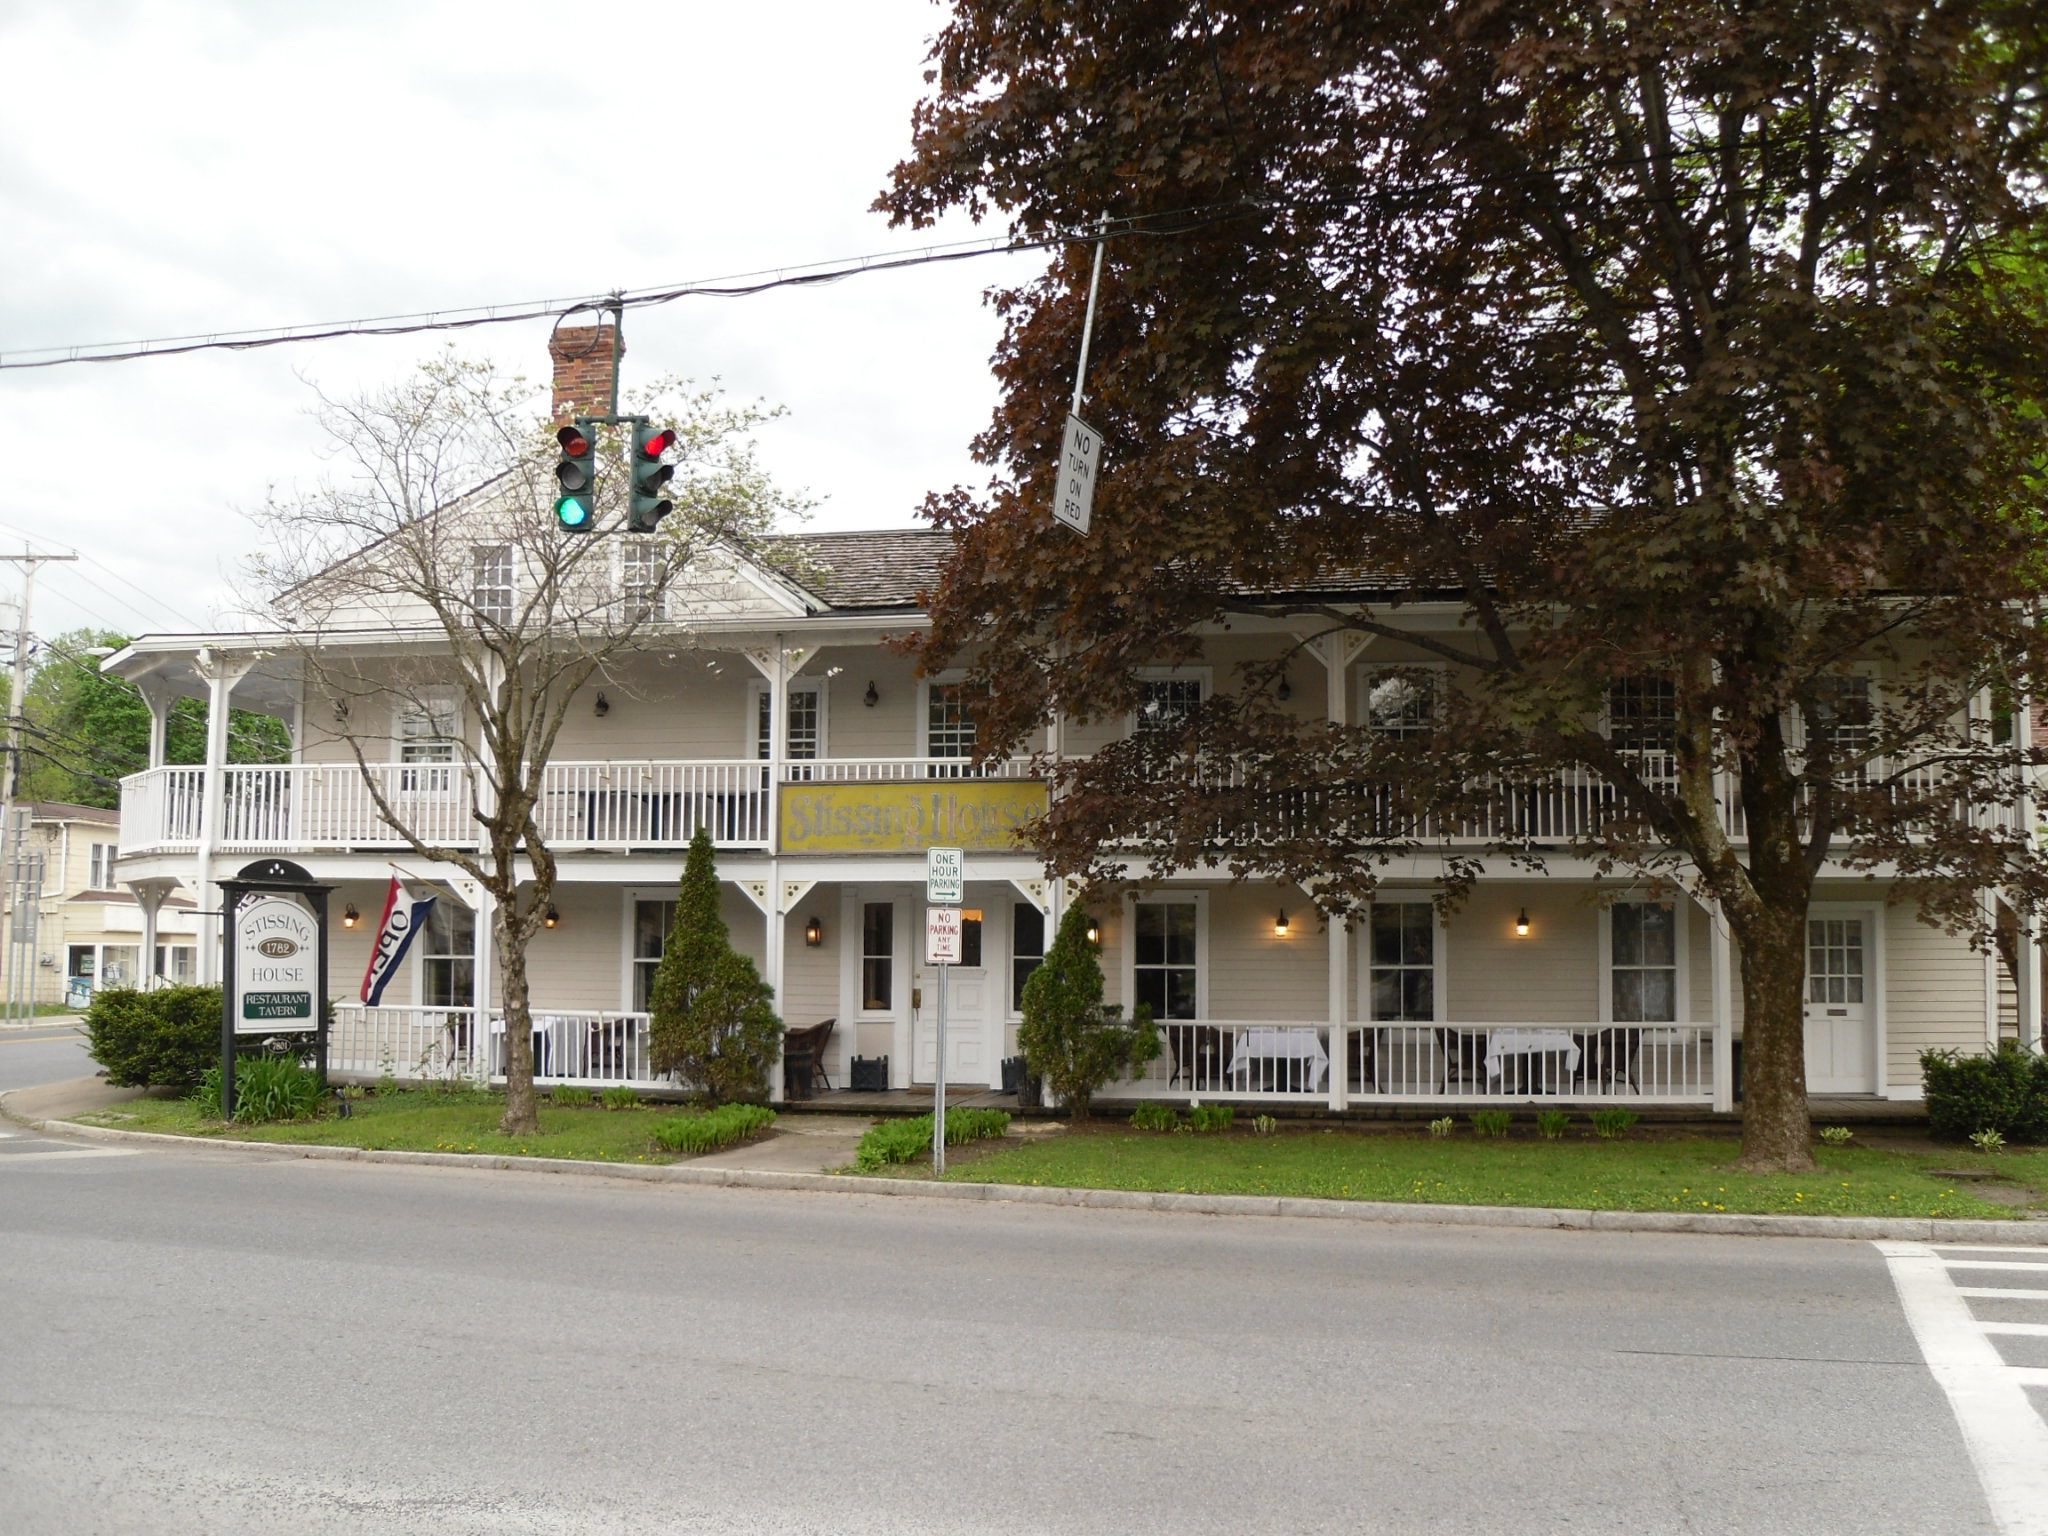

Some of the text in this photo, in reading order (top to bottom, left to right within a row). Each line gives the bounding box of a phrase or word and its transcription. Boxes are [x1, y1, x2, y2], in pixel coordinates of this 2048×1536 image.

[1074, 430, 1090, 454] NO
[1069, 454, 1089, 479] TURN
[1070, 479, 1081, 498] ON
[1064, 500, 1080, 520] RED
[935, 854, 955, 865] ONE
[932, 866, 958, 877] HOUR
[930, 878, 960, 890] PARKING
[938, 913, 951, 923] NO
[245, 914, 309, 941] STISSING
[929, 924, 959, 935] PARKING
[937, 936, 951, 944] ANY
[266, 942, 290, 954] 1782
[937, 944, 951, 952] TIME
[252, 967, 304, 982] HOUSE
[246, 994, 309, 1005] RESTAURANT
[258, 1006, 297, 1016] TAVERN
